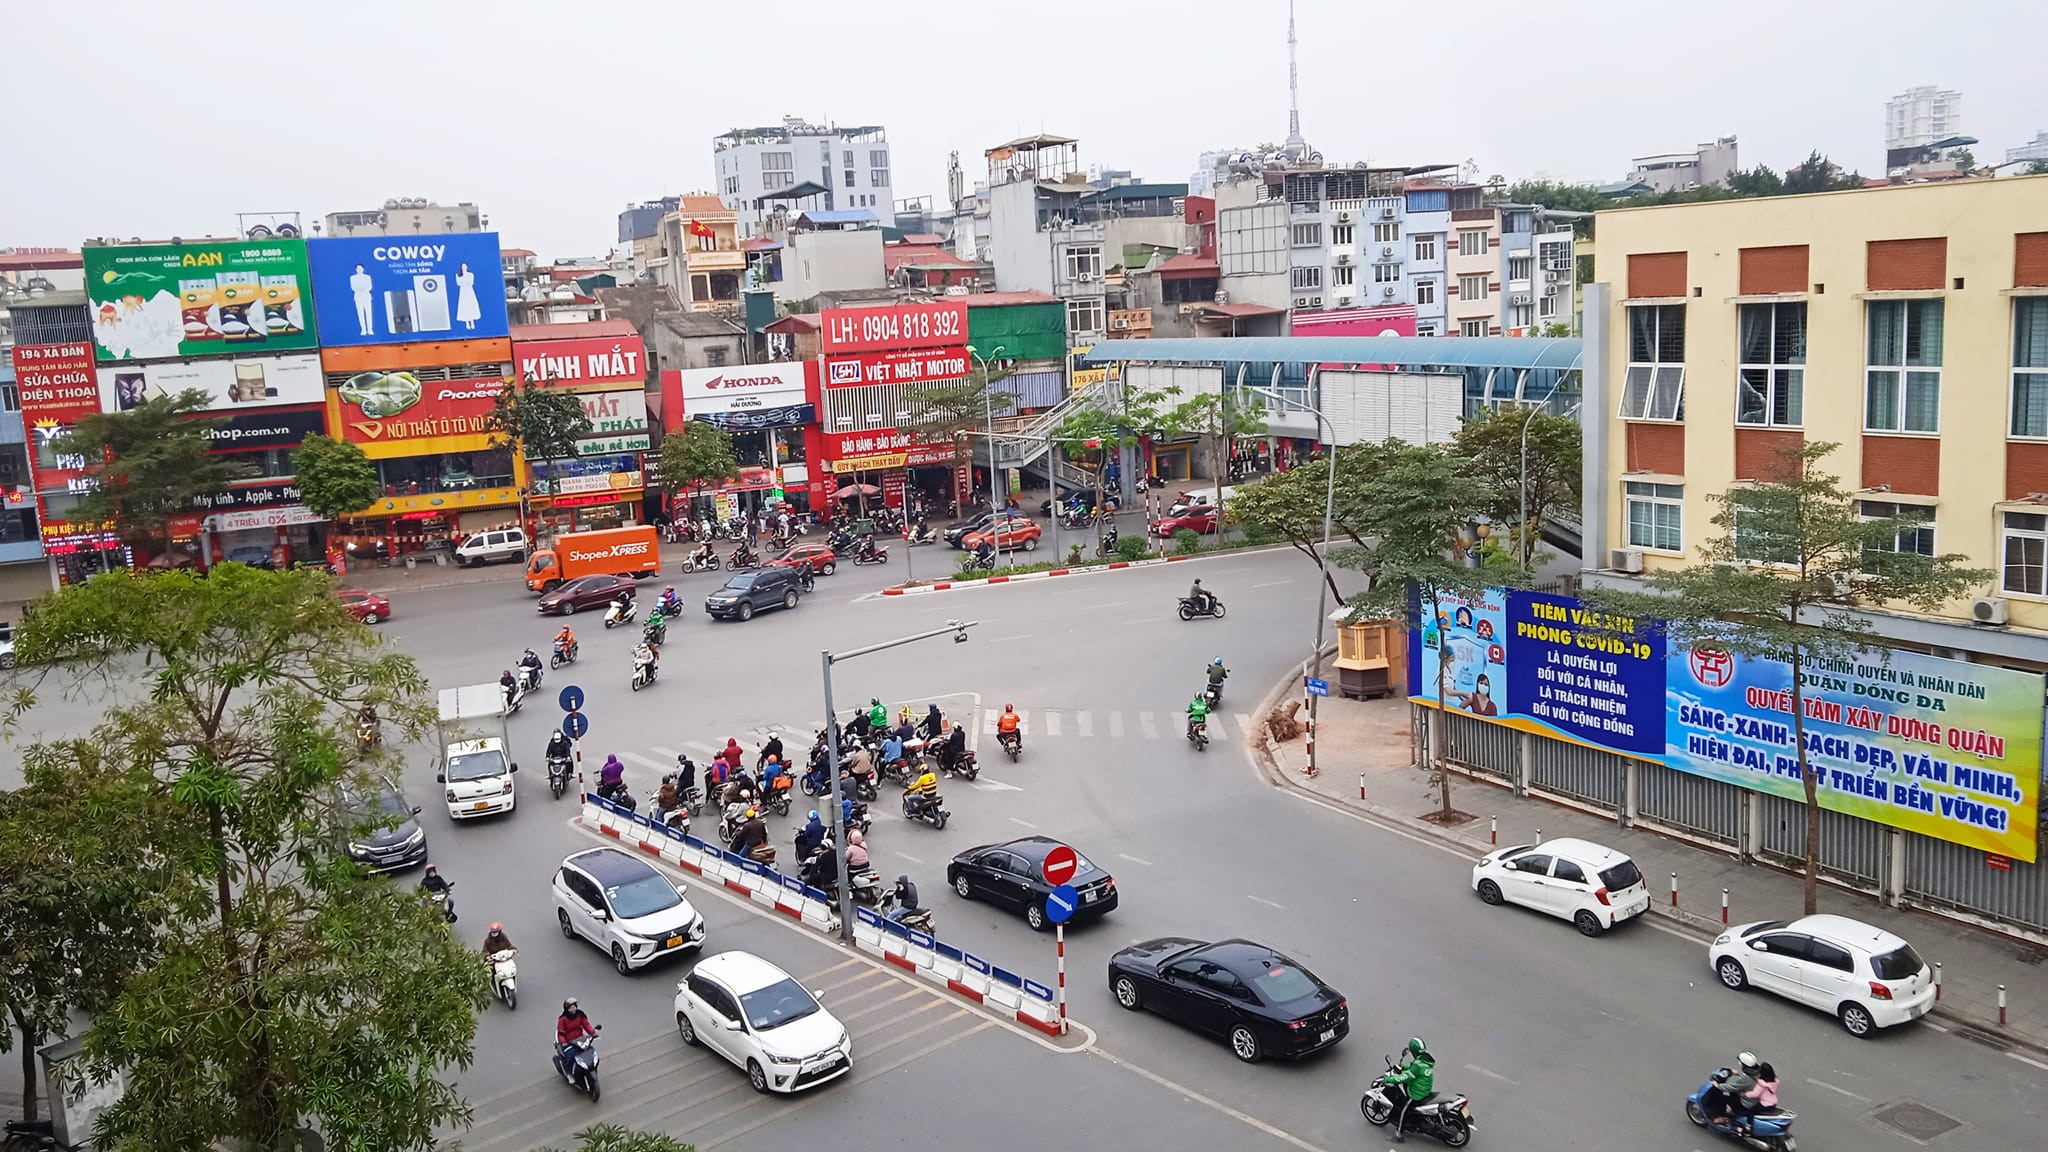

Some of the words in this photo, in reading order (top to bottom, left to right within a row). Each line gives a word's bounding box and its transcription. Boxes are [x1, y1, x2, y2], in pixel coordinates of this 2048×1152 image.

[831, 317, 858, 343] LH:
[863, 314, 899, 342] 0904
[903, 312, 929, 339] 818
[933, 310, 959, 337] 392
[21, 350, 40, 359] 194
[522, 352, 582, 381] KÍNH
[587, 344, 637, 378] MẮT
[24, 372, 51, 387] SỬA
[53, 371, 89, 384] CHỮA
[723, 376, 783, 388] HONDA
[866, 361, 891, 383] VIỆT
[895, 358, 923, 380] NHẬT
[926, 358, 965, 377] MOTOR
[56, 386, 97, 399] THOẠI
[437, 388, 504, 401] Pioneer
[581, 393, 620, 418] MẮT
[387, 420, 407, 440] NỘI
[408, 414, 438, 437] THẤT
[441, 416, 450, 434] Ô
[451, 415, 467, 433] TÔ
[601, 416, 643, 432] PHÁT
[583, 441, 605, 453] ĐÂU
[626, 438, 649, 450] HƠN
[841, 435, 855, 453] BẢO
[855, 435, 873, 452] HÀNH
[872, 459, 888, 468] THAY
[9, 493, 22, 503] 49
[193, 491, 212, 507] Máy
[216, 492, 234, 505] tính
[245, 489, 273, 504] Apple
[283, 487, 300, 501] Phụ
[268, 514, 287, 524] 0%
[569, 551, 608, 562] Shopee
[609, 544, 649, 557] XPRESS
[1531, 602, 1568, 622] TIÊM
[1517, 622, 1572, 645] PHÒNG
[1576, 631, 1652, 660] COVID-19
[1547, 649, 1560, 665] LÀ
[1600, 661, 1618, 677] LỢI
[1537, 665, 1555, 682] ĐỐI
[1557, 670, 1574, 686] VỚI
[1577, 674, 1592, 689] CÁ
[1594, 680, 1628, 698] NHÂN,
[1799, 672, 1846, 693] QUẬN
[1853, 683, 1910, 704] ĐỐNG
[1916, 695, 1946, 712] ĐA
[1900, 670, 1915, 686] VÀ
[1918, 675, 1954, 694] NHÂN
[1958, 682, 1986, 700] DÂN
[1539, 685, 1552, 699] LÀ
[1554, 688, 1588, 707] TRÁCH
[1590, 695, 1627, 715] NHIỆM
[1532, 701, 1550, 717] ĐỐI
[1552, 705, 1569, 721] VỚI
[1572, 711, 1600, 728] CỘNG
[1747, 687, 1795, 714] QUYẾT
[1803, 697, 1841, 724] TÂM
[1845, 705, 1884, 732] XÂY
[1887, 714, 1941, 745] DỰNG
[1948, 728, 2006, 760] QUẬN
[1801, 731, 1849, 760] SẠCH
[1854, 743, 1897, 773] ĐẸP,
[1903, 754, 1948, 783] VĂN
[1954, 765, 2021, 803] MINH,
[1689, 735, 1728, 761] HIỆN
[1733, 746, 1771, 775] ĐẠI,
[1831, 766, 1887, 800] TRIỂN
[1893, 782, 1934, 812] BỀN
[1939, 795, 2008, 831] VỮNG!
